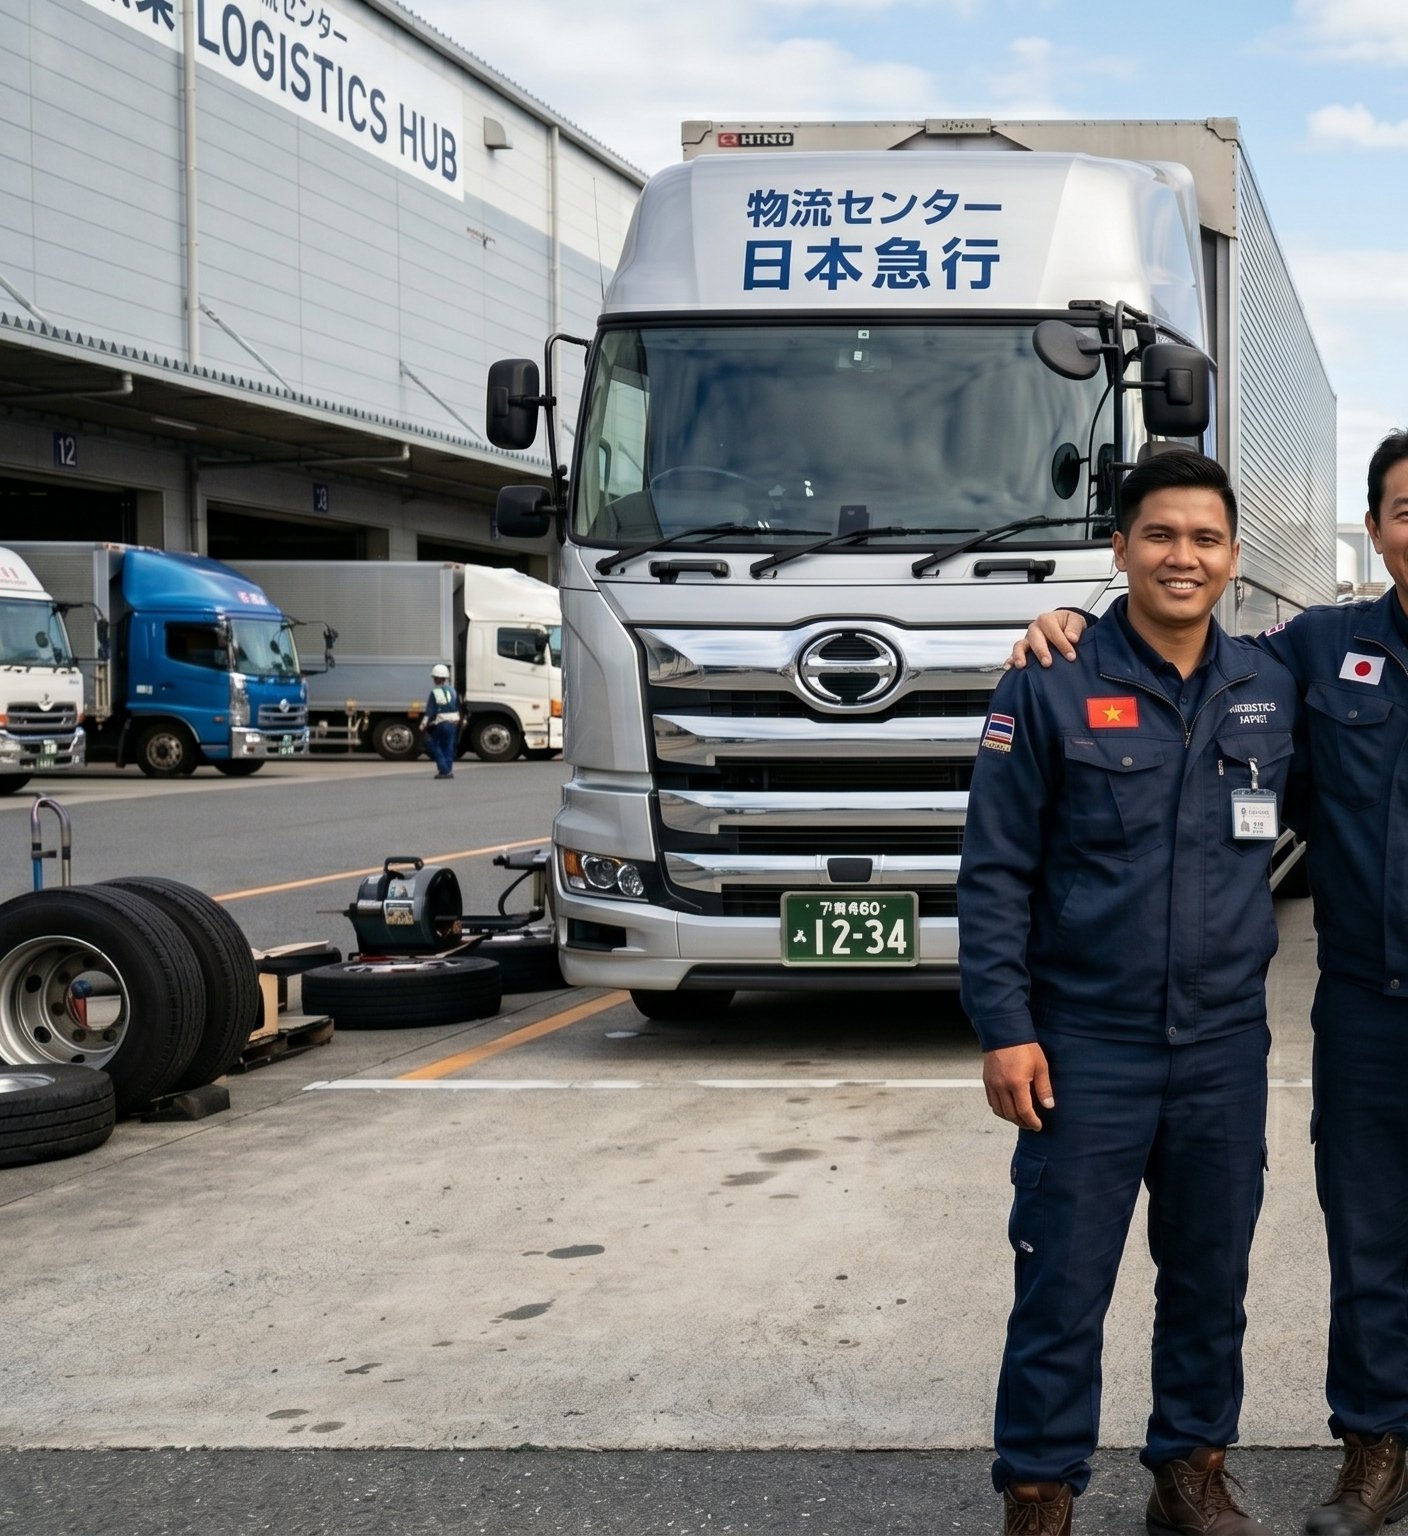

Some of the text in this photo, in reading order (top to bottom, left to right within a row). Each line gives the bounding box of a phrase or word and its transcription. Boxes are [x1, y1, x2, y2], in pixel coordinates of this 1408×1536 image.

[198, 0, 457, 182] LOGISTICS HUB
[741, 134, 791, 145] HINO
[747, 188, 1002, 228] 物流センター
[743, 237, 1000, 291] 日本急行
[58, 437, 76, 466] 12
[815, 918, 907, 955] 12-34
